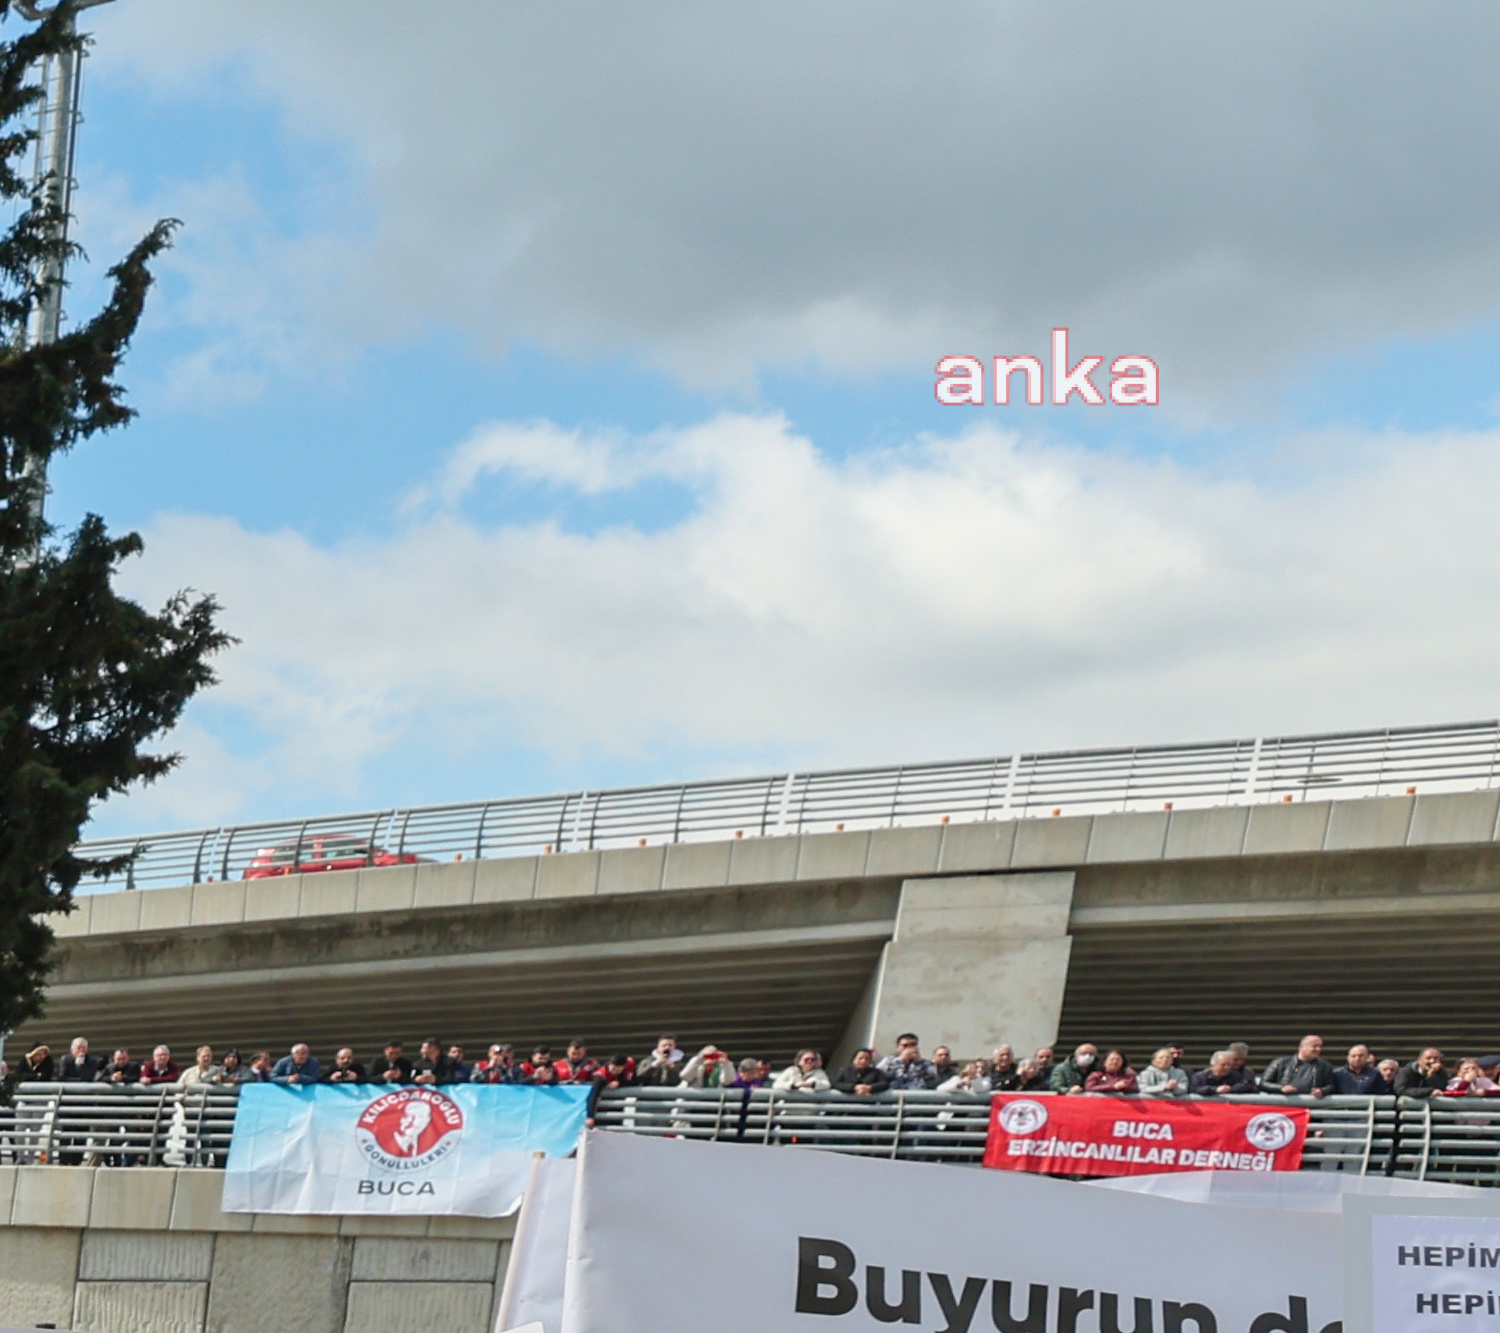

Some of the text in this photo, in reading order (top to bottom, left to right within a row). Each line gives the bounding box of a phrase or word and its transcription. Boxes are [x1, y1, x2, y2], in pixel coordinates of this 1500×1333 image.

[1113, 1120, 1173, 1140] BUCA
[1007, 1138, 1274, 1171] ERZİNCANLILAR DERNEĞİ
[357, 1180, 435, 1195] BUCA
[1416, 1291, 1500, 1315] HEPİ
